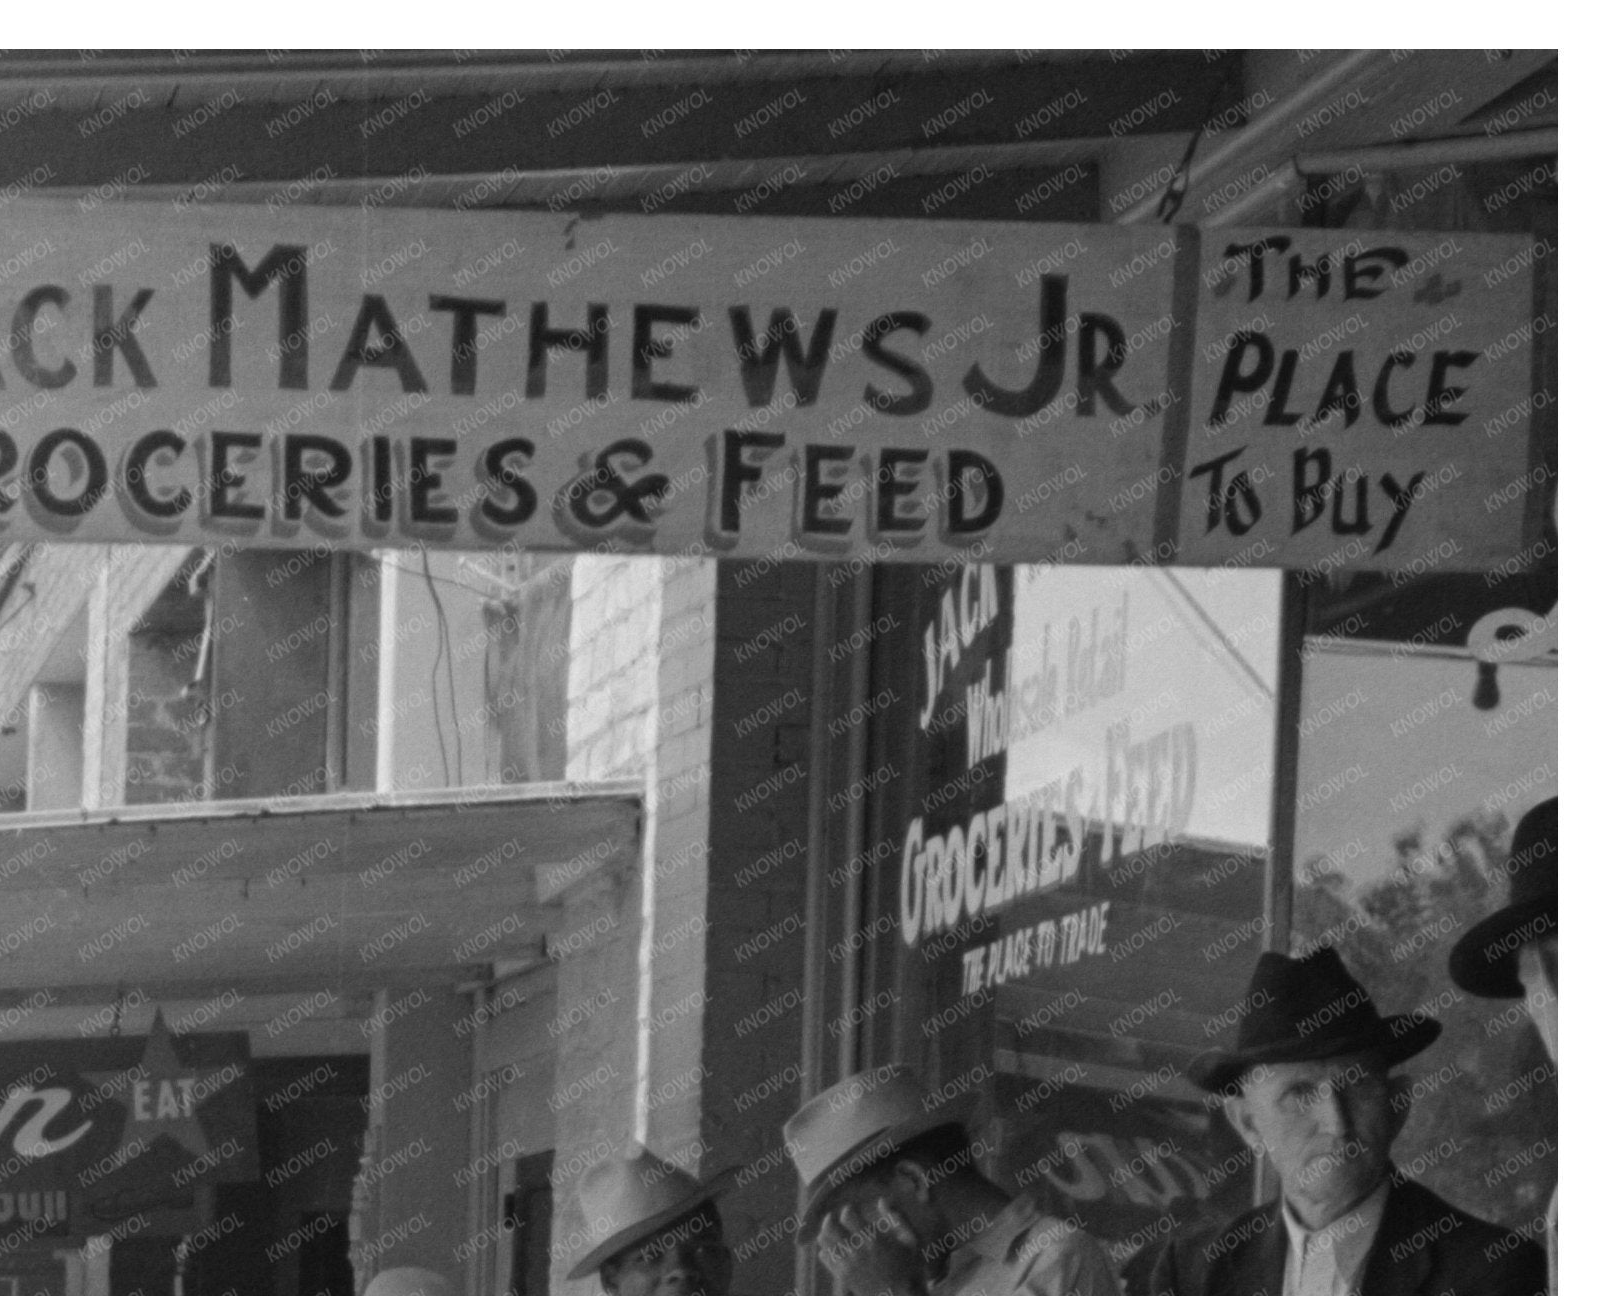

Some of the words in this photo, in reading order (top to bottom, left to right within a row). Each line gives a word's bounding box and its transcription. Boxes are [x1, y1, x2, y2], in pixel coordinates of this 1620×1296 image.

[1223, 235, 1409, 302] THE
[208, 242, 935, 416] MATHEWS
[1209, 330, 1481, 430] PLACE
[565, 438, 670, 530] &
[721, 429, 1006, 536] FEED
[133, 1078, 196, 1122] EAT
